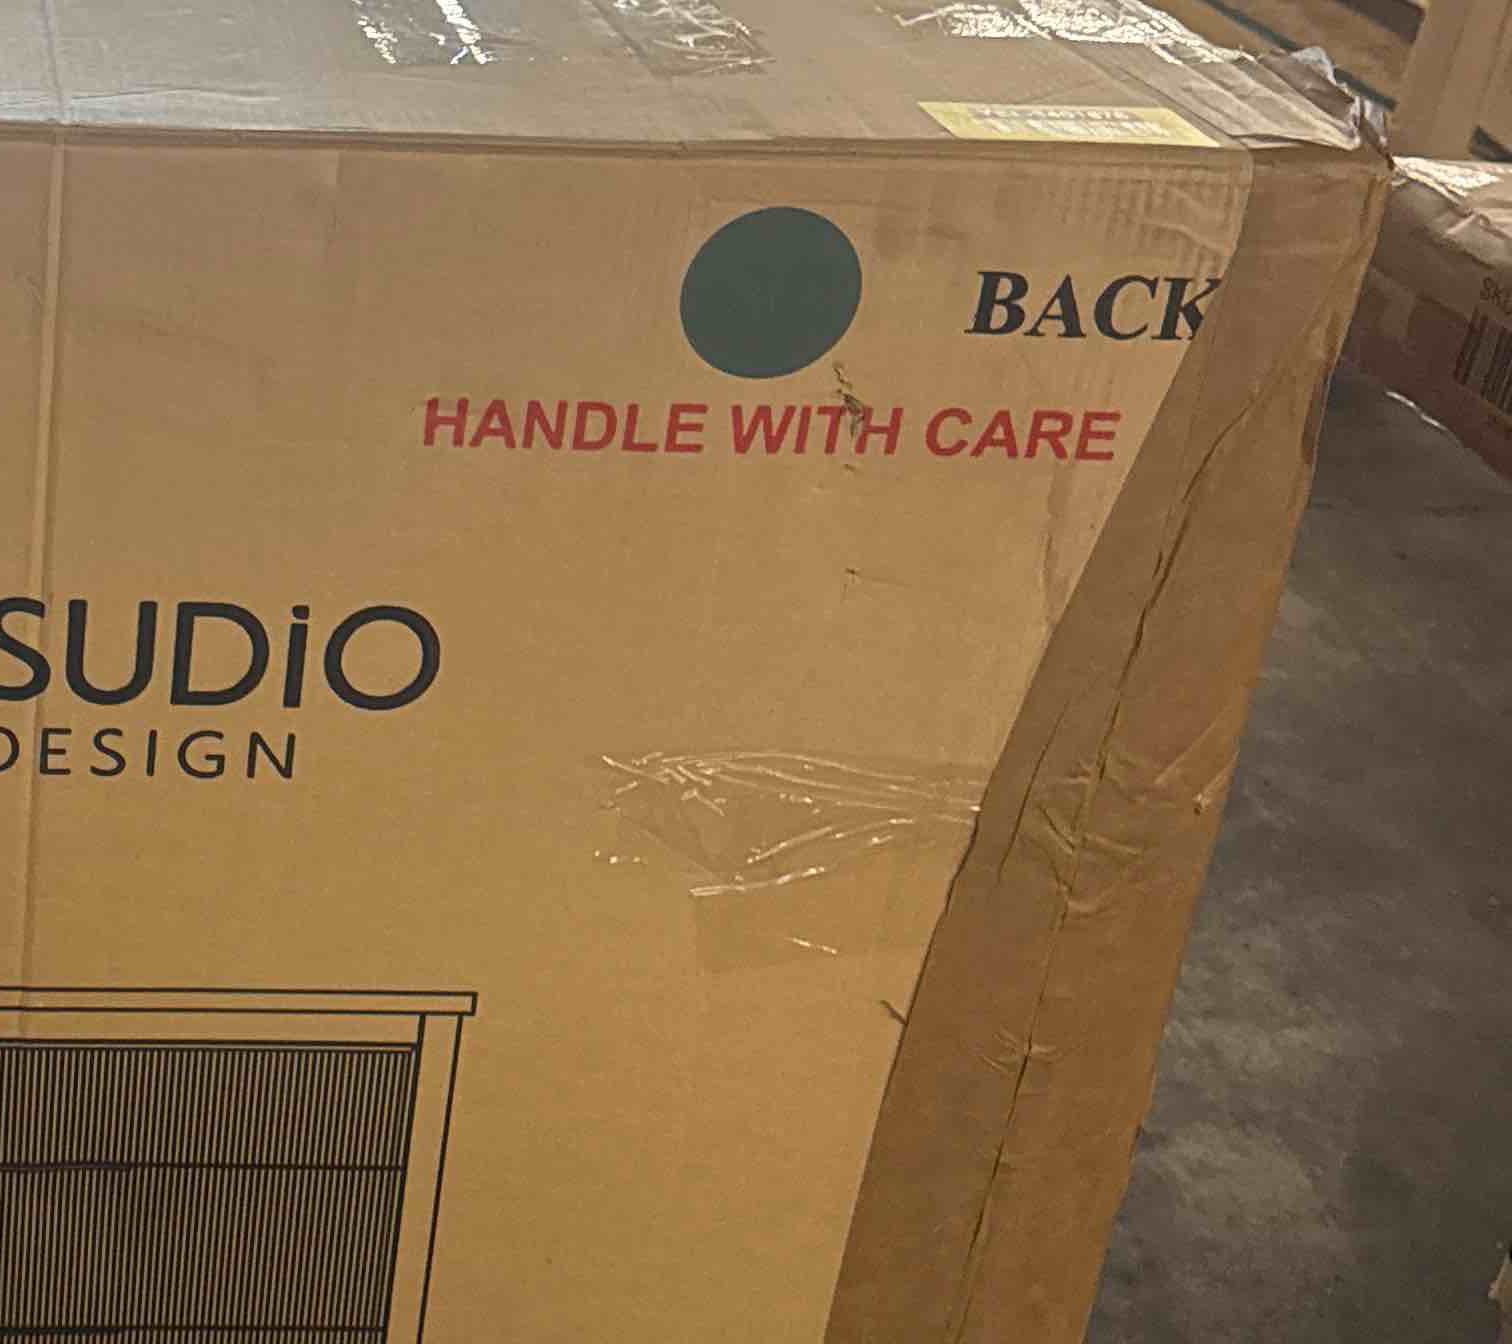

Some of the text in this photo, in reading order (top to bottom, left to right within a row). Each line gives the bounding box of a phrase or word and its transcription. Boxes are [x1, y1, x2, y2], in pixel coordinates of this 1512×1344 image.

[963, 269, 1223, 342] BACK
[422, 395, 1123, 462] HANDLE WITH CARE
